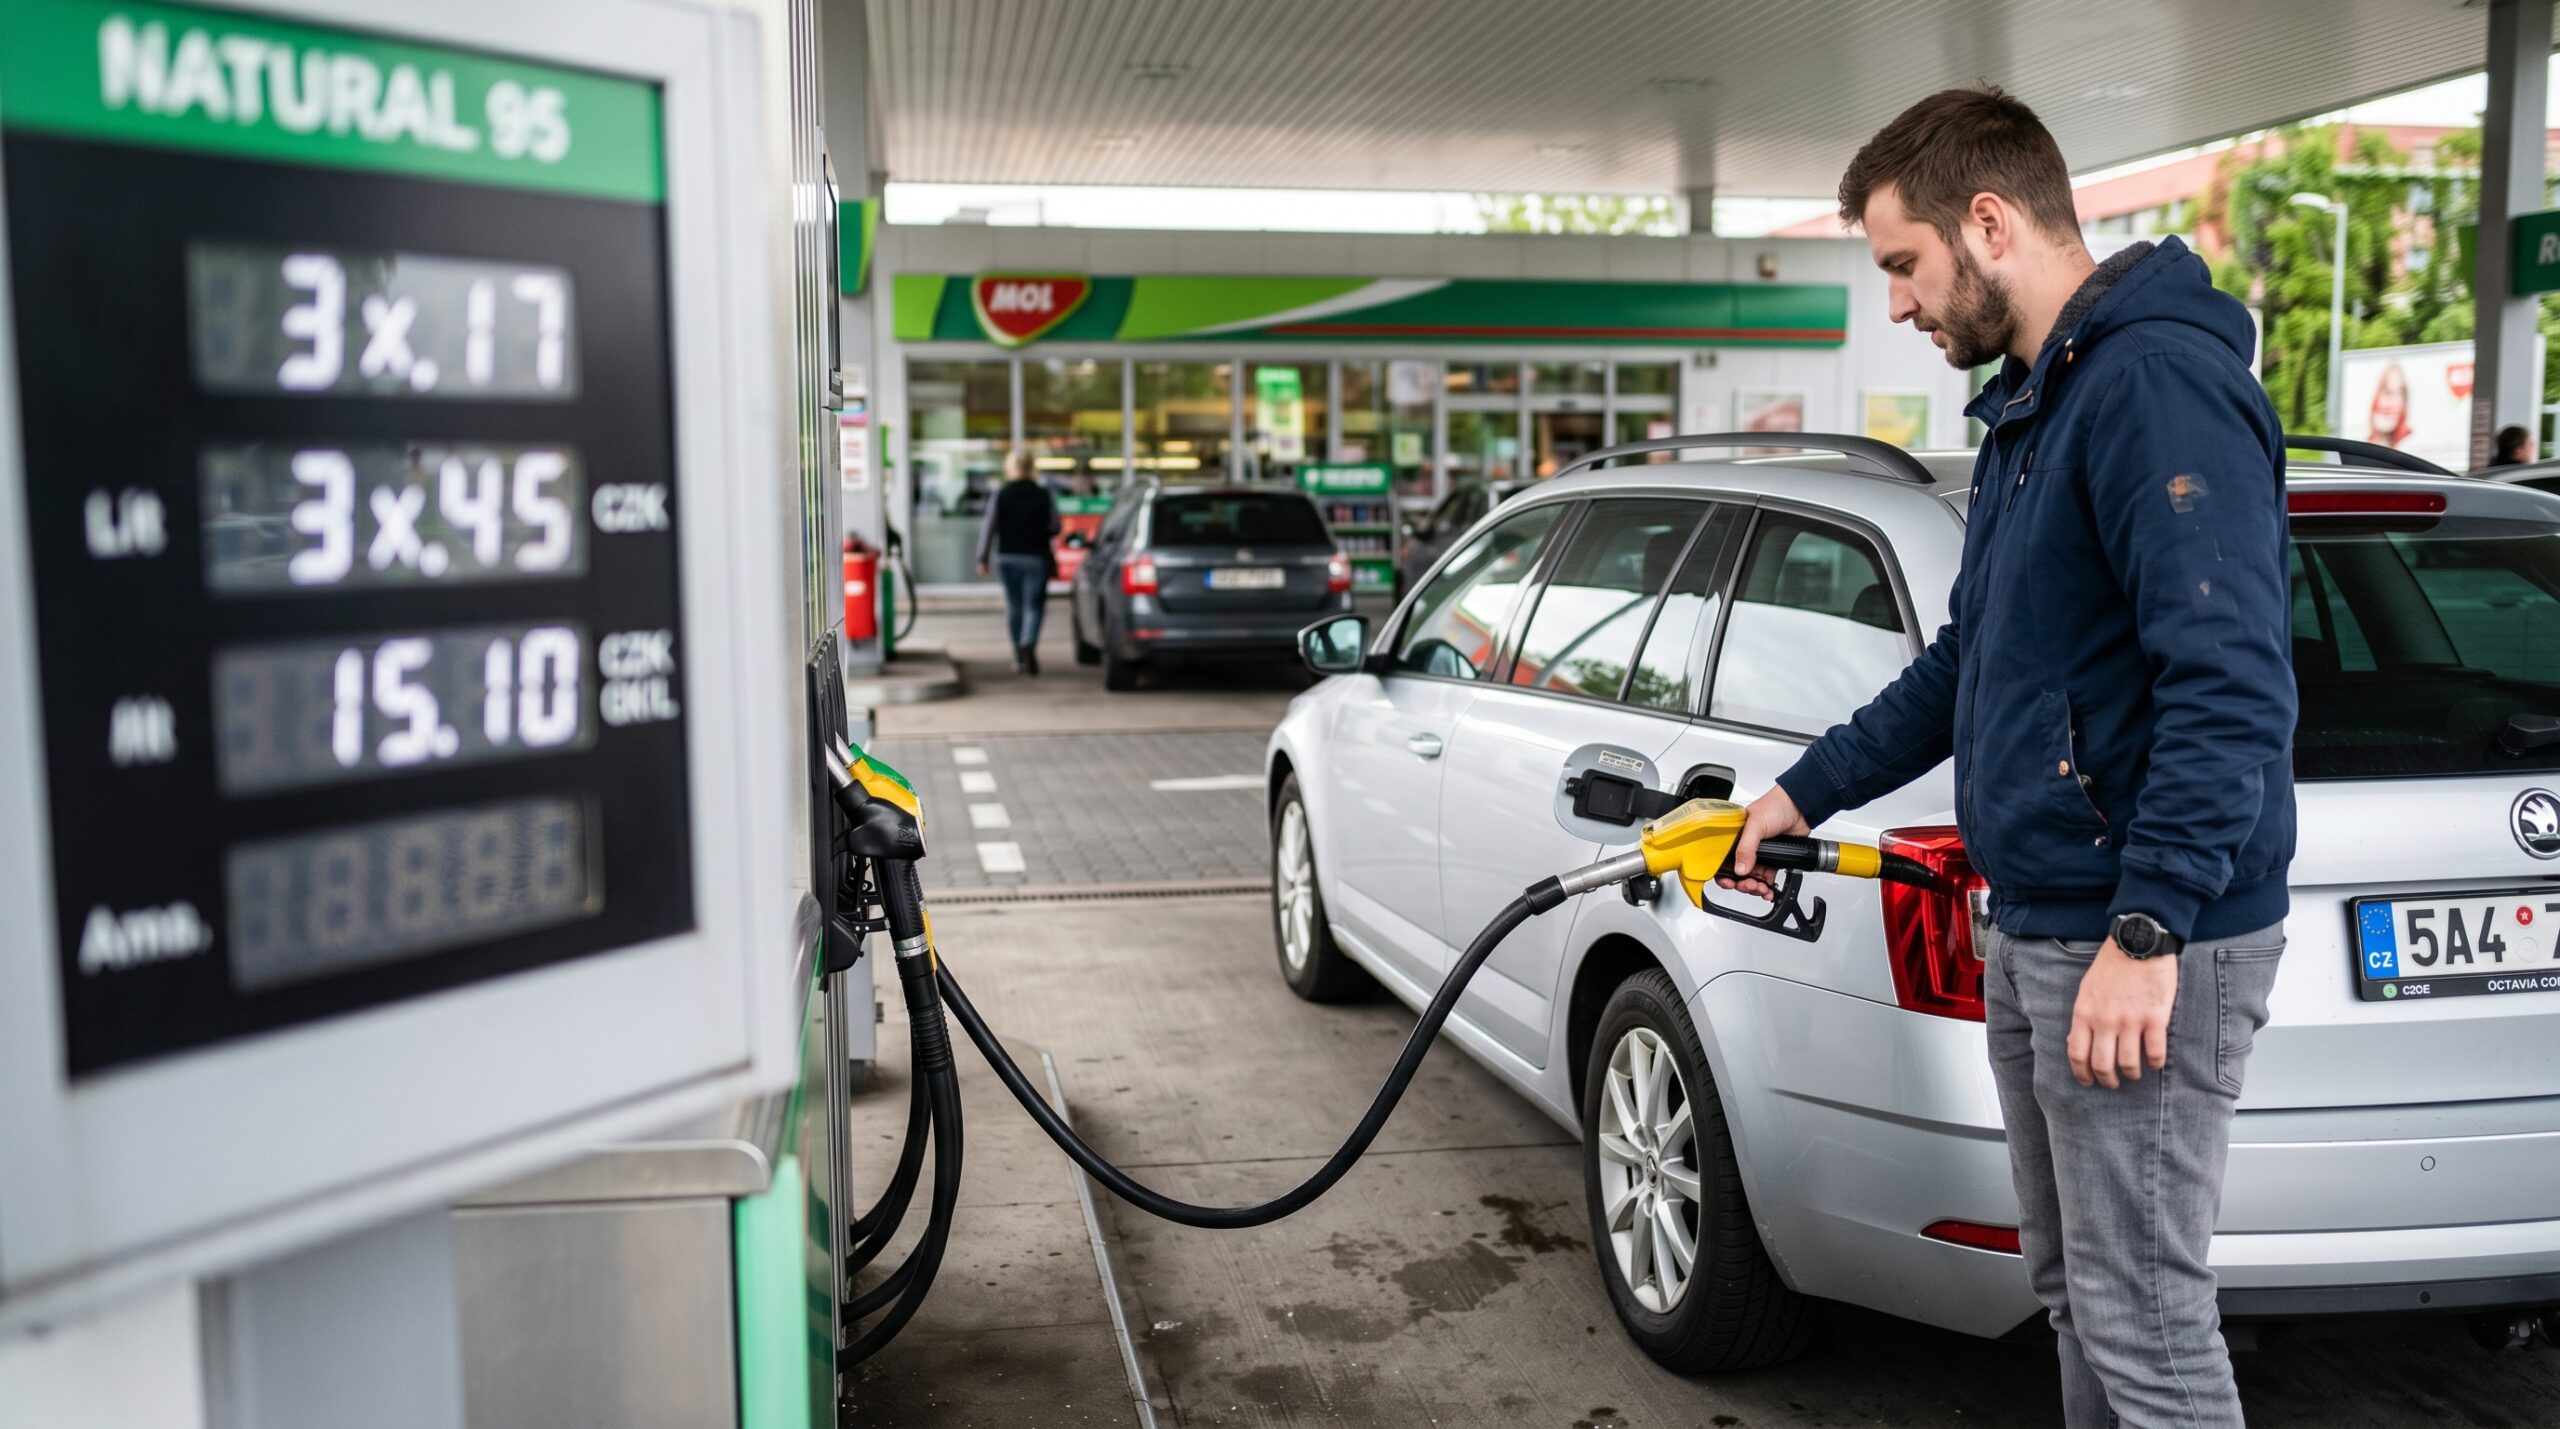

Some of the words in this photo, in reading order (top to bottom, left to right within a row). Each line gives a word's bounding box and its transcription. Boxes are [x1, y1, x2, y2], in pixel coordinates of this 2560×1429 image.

[98, 14, 480, 152] NATURAL
[486, 80, 571, 163] 95
[2538, 231, 2560, 266] R
[277, 253, 565, 391] 3x.17
[989, 282, 1053, 312] MOL
[289, 450, 572, 585] 3x.45
[592, 483, 670, 533] CZK
[2368, 951, 2393, 969] CZ
[2406, 906, 2507, 968] 5A4
[2487, 978, 2539, 991] OCTAVIA
